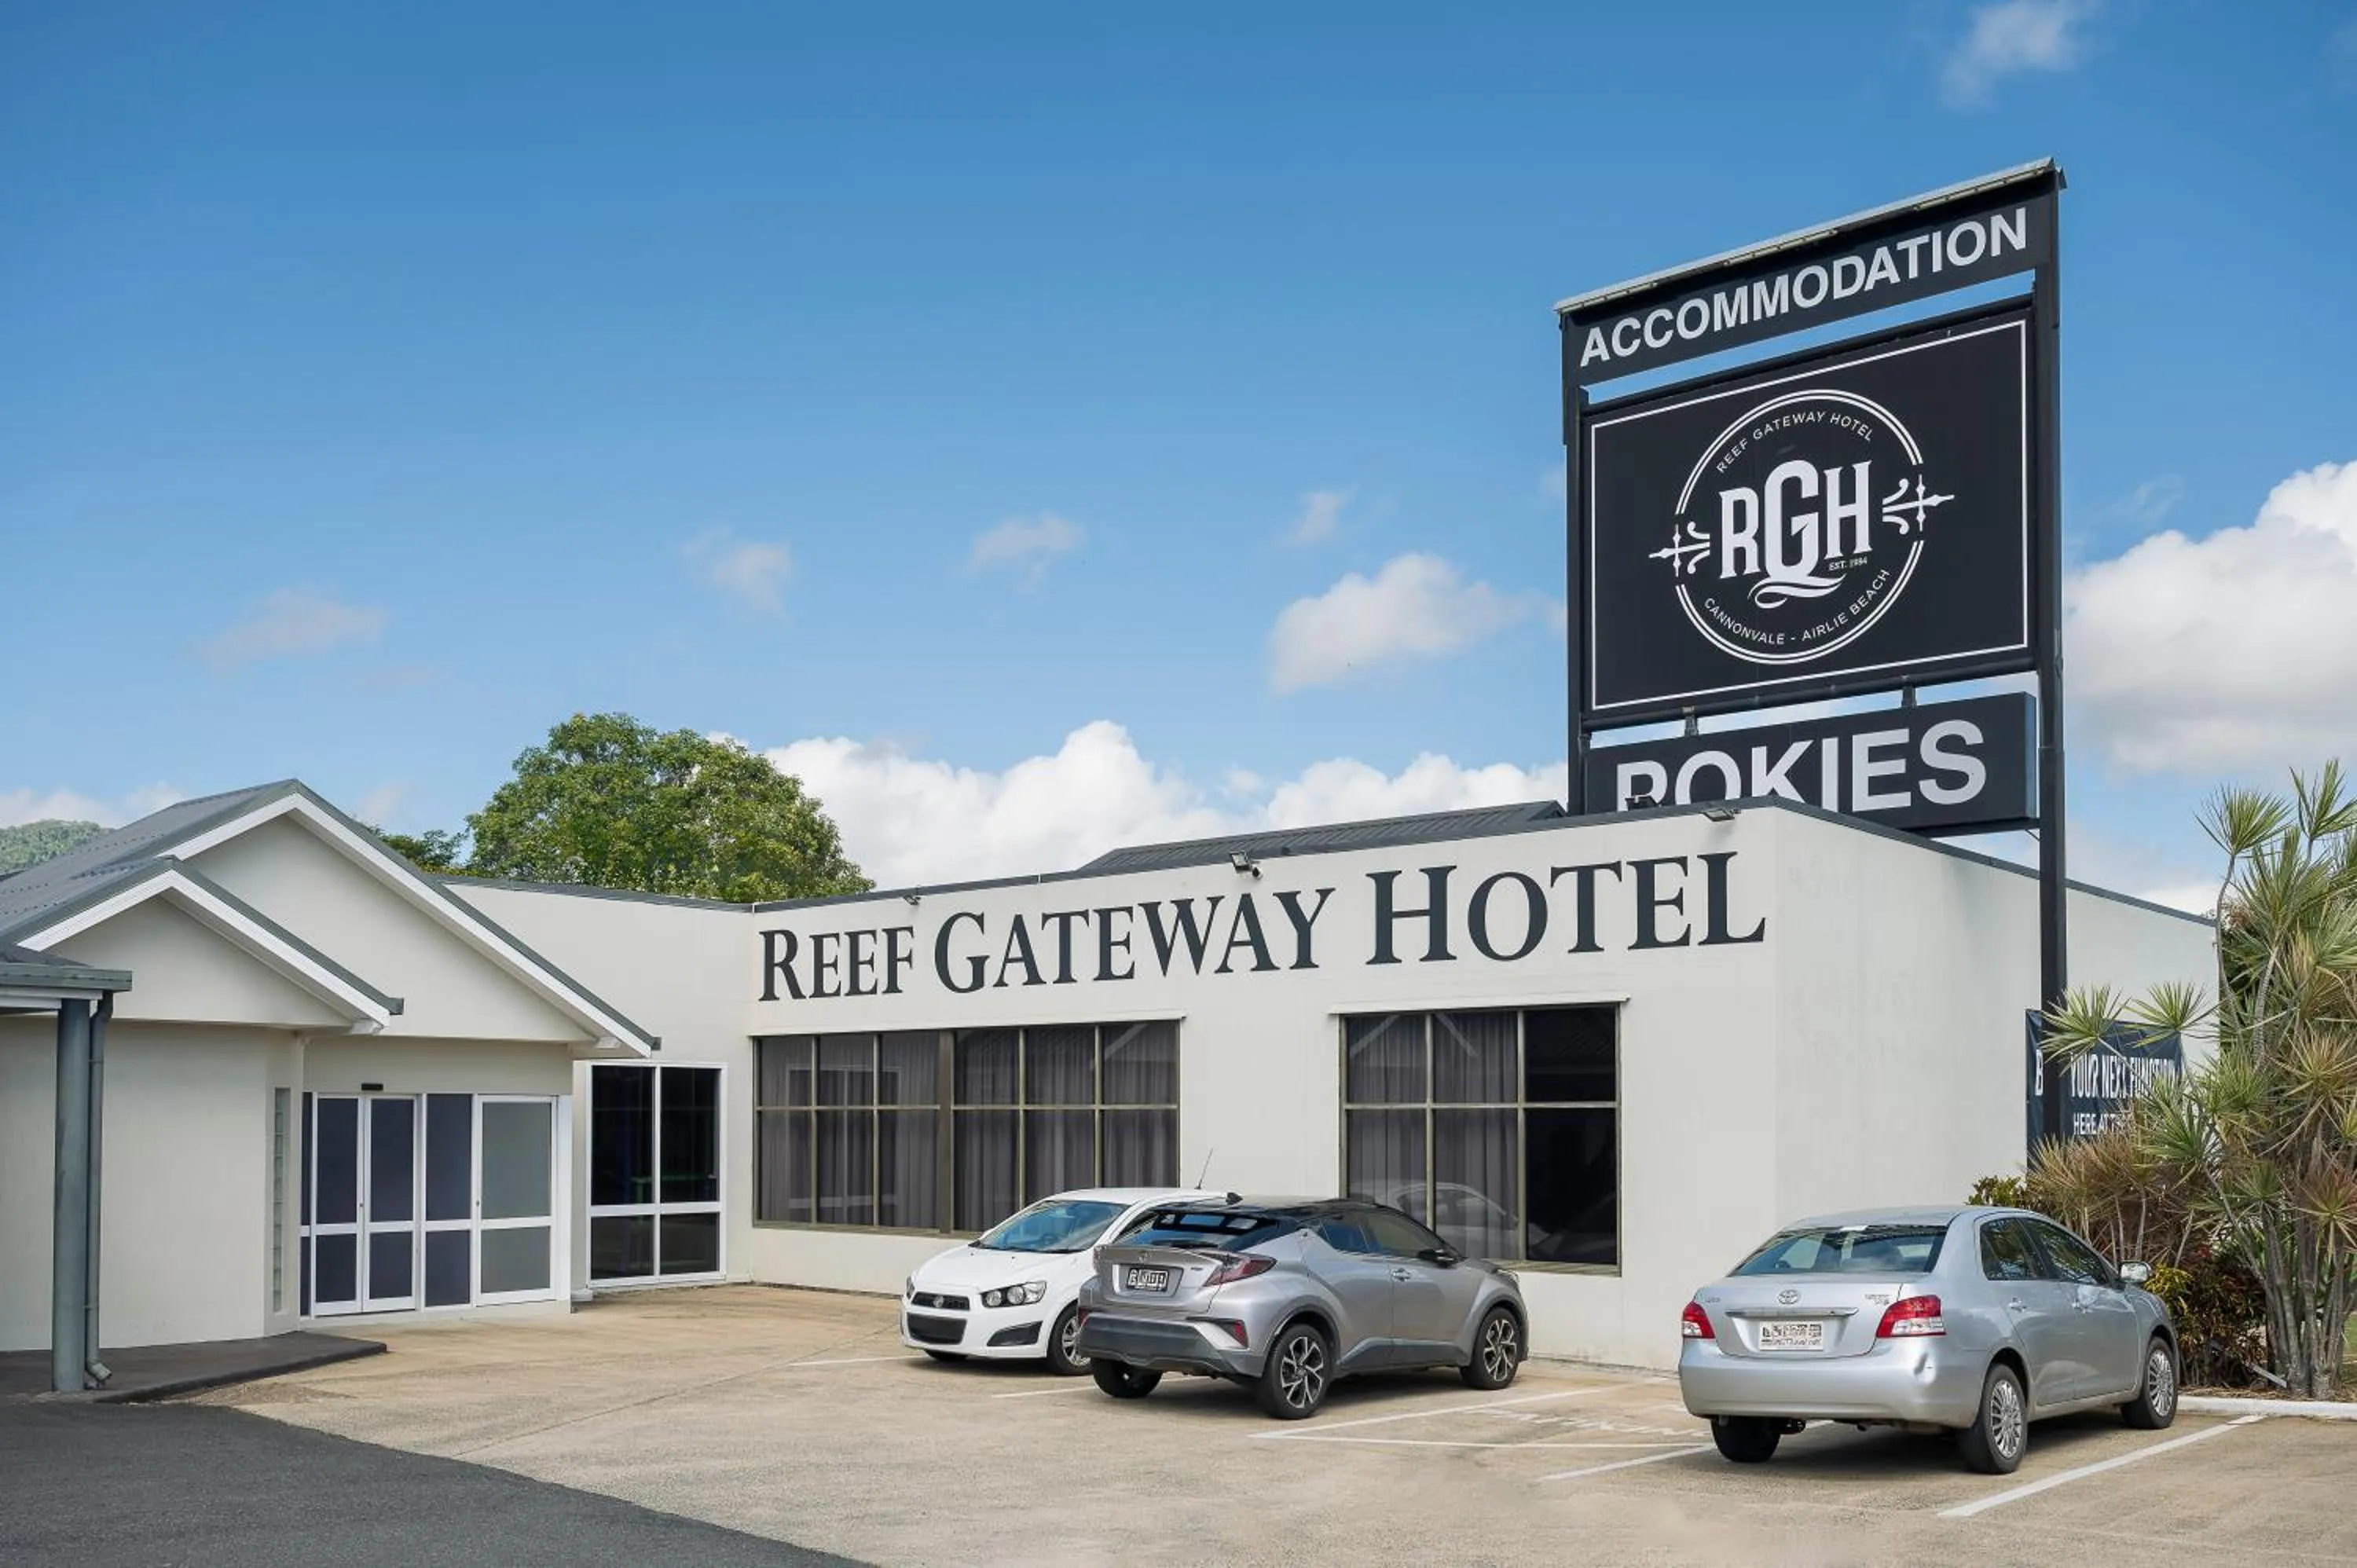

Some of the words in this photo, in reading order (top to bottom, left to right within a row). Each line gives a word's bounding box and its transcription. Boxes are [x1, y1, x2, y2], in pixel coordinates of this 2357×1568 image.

[1580, 207, 2027, 368] ACCOMMODATION
[1716, 439, 1749, 474] REEF
[1753, 411, 1826, 441] GATEWAY
[1830, 412, 1874, 441] HOTEL
[1718, 460, 1873, 609] RGH
[1704, 597, 1785, 645] CANNONVALE
[1802, 612, 1849, 642] AIRLIE
[1849, 569, 1890, 615] BEACH
[1617, 720, 1987, 812] POKIES
[758, 925, 915, 1002] REEF
[934, 887, 1336, 994] GATEWAY
[1365, 851, 1766, 965] HOTEL
[2070, 1052, 2099, 1097] YOUR
[2073, 1112, 2097, 1135] HERE
